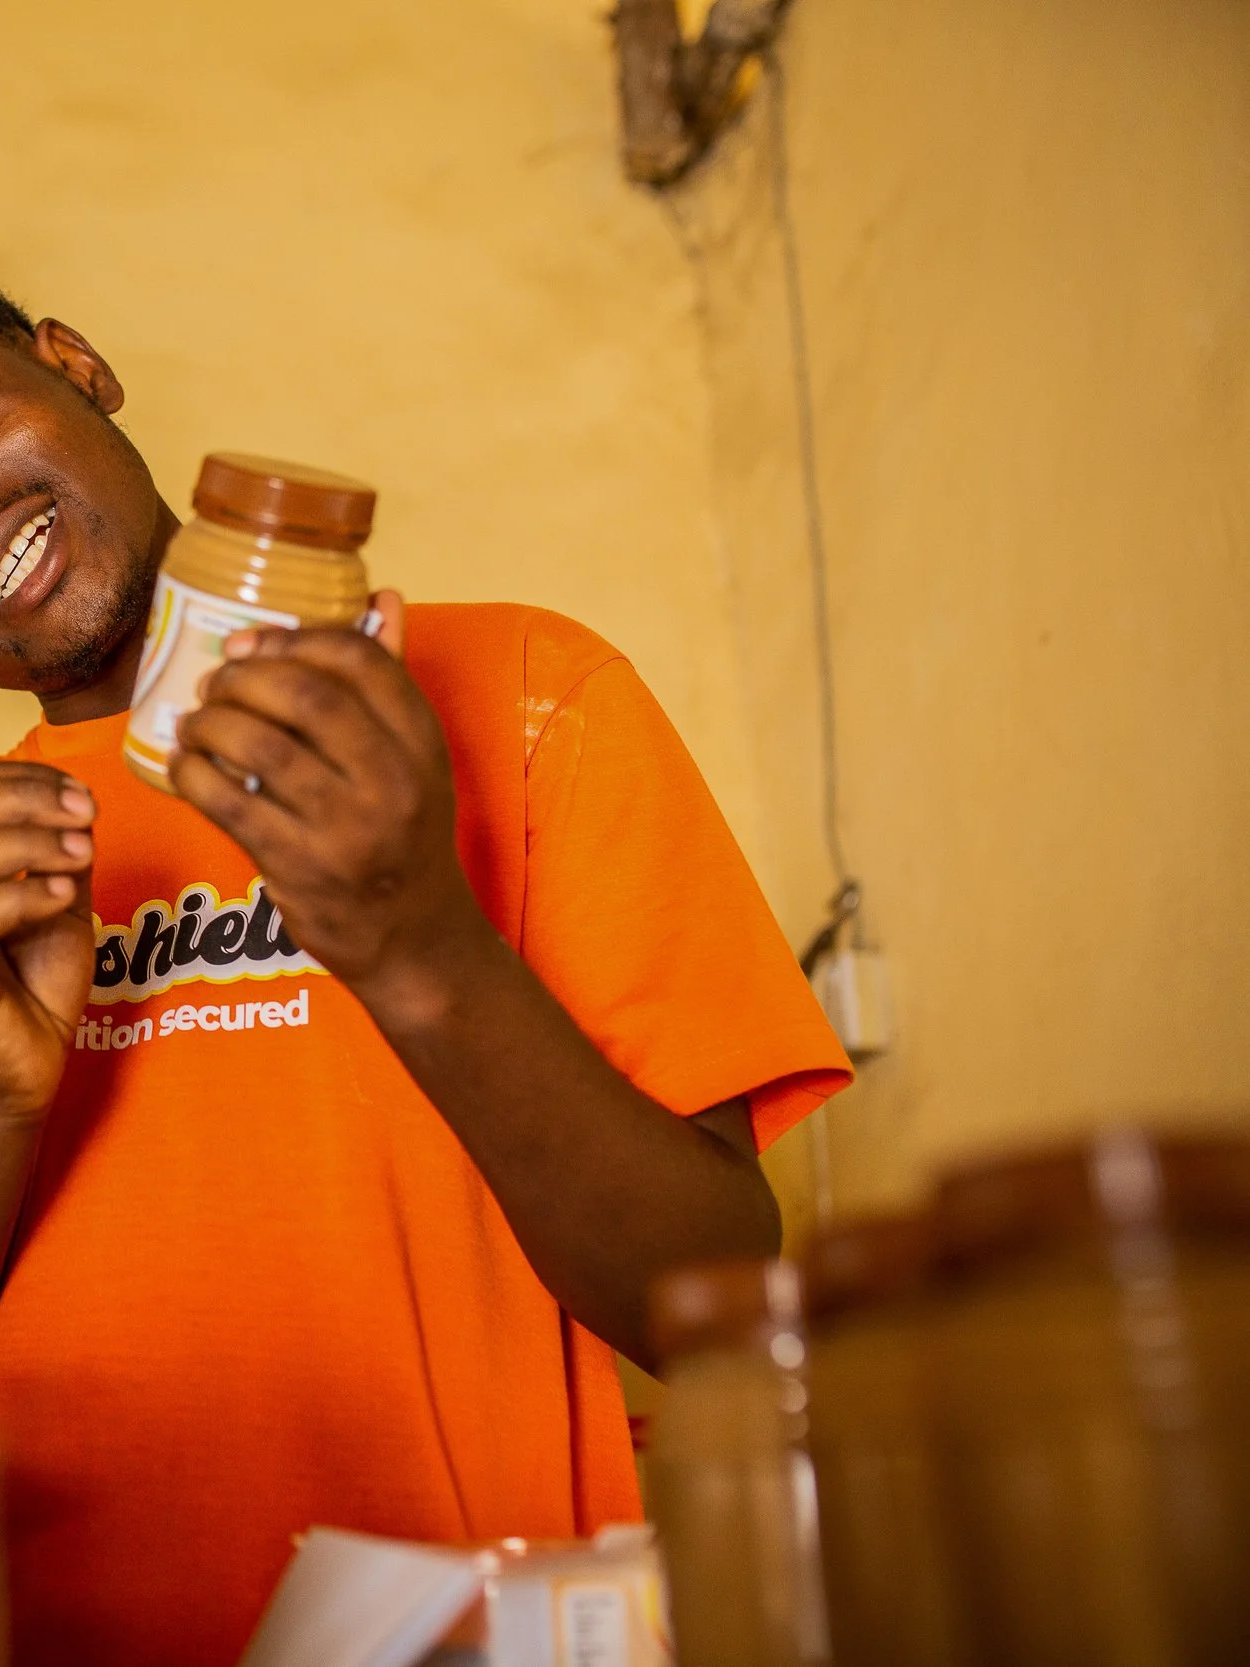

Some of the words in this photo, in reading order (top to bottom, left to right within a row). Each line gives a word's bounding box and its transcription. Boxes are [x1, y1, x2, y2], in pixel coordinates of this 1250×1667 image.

[93, 886, 303, 988] shiel
[75, 1015, 154, 1051] ition
[158, 989, 310, 1037] secured
